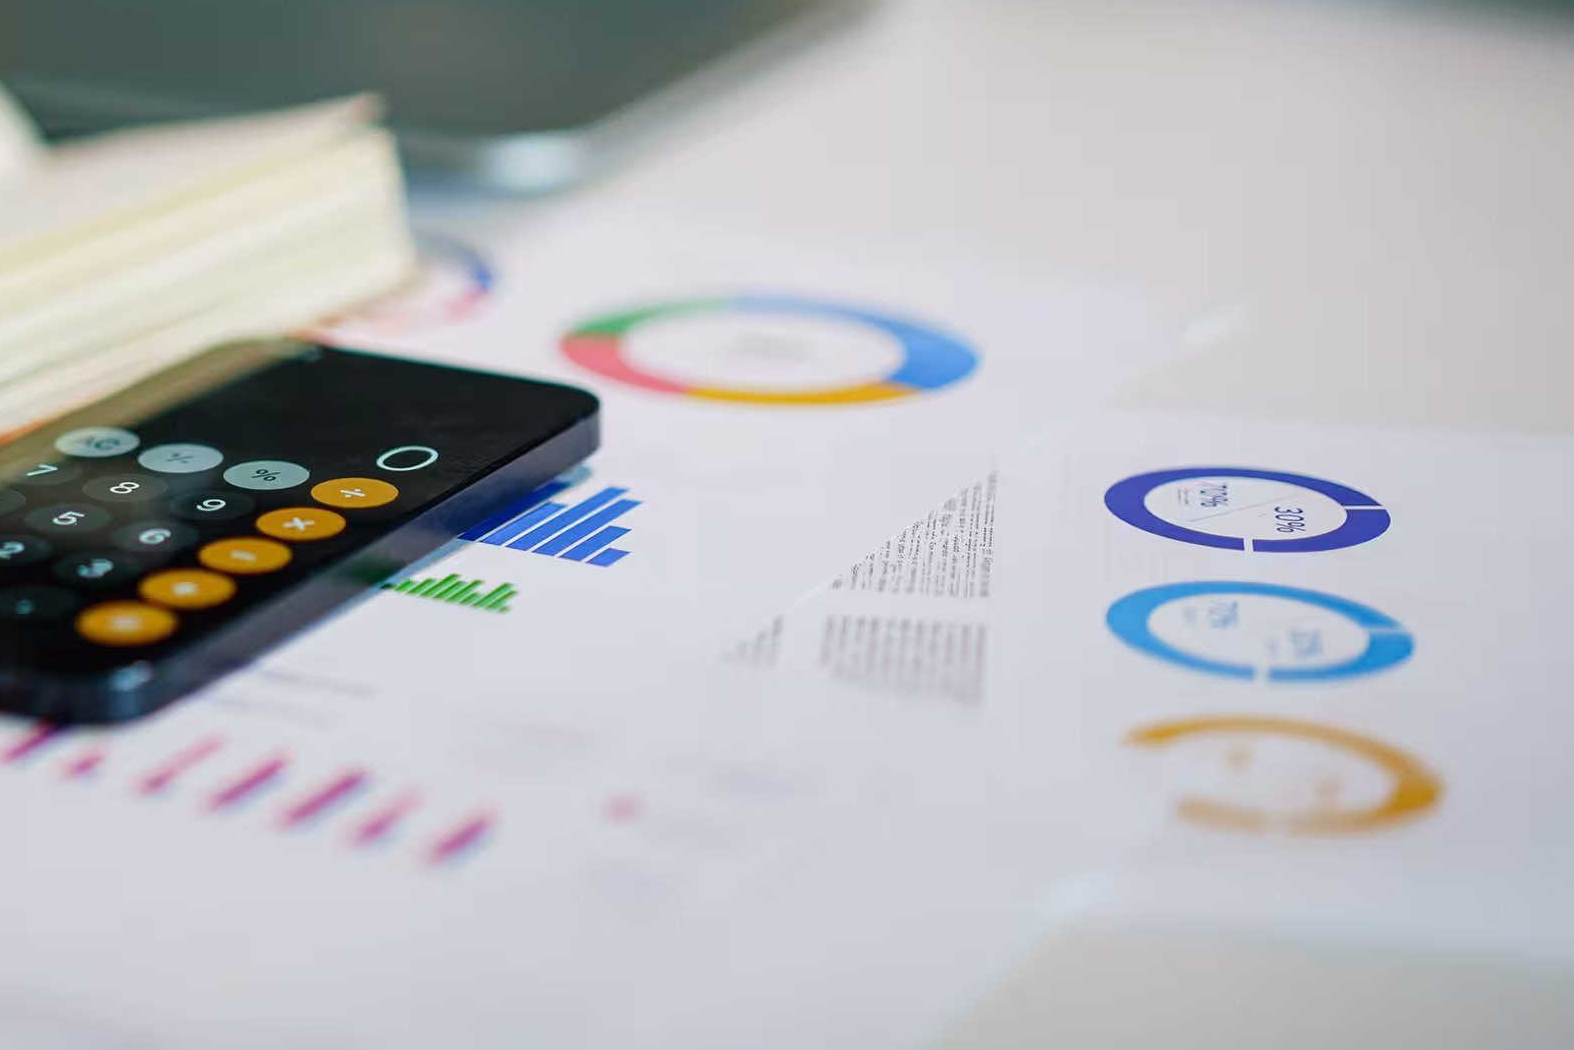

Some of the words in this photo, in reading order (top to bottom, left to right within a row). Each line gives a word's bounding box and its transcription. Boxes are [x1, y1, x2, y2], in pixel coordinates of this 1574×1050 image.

[376, 445, 439, 472] 0
[26, 463, 58, 477] 7
[109, 481, 140, 494] 8
[196, 498, 227, 512] 9
[52, 510, 85, 526] 5
[138, 528, 172, 545] 6
[1274, 505, 1307, 533] 30%
